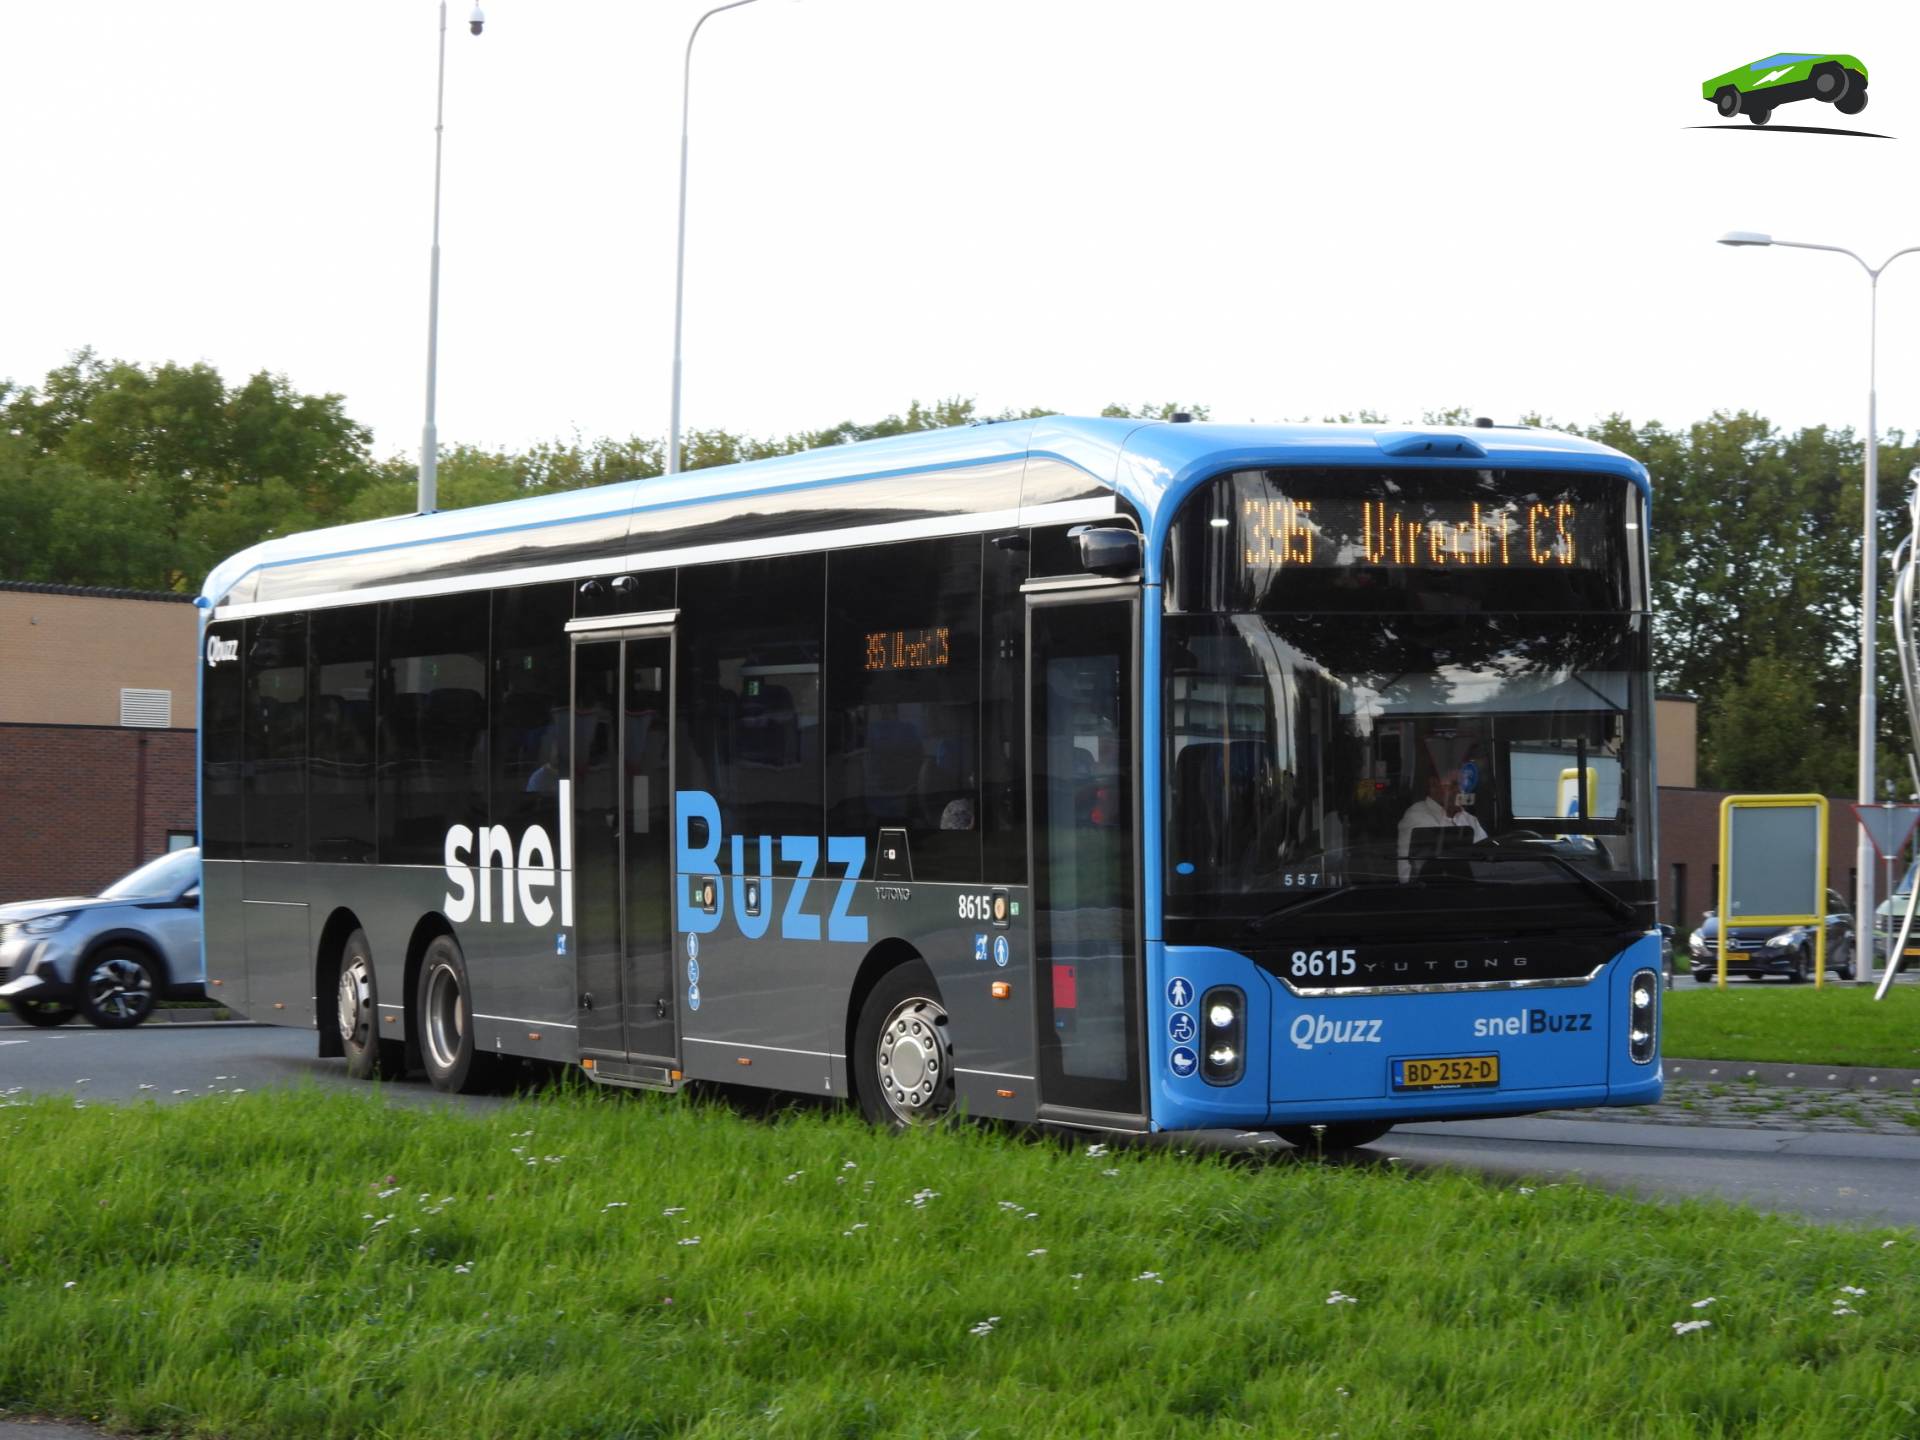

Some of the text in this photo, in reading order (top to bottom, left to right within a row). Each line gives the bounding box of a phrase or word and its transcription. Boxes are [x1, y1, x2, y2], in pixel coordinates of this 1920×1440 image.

[1245, 501, 1575, 564] 395 Utrecht CS
[443, 779, 869, 943] snel Buzz
[875, 886, 912, 902] YUTONG
[958, 894, 990, 920] 8615
[1291, 949, 1357, 977] 8615
[1364, 957, 1527, 972] YUTONG
[1290, 1014, 1383, 1050] Qbuzz
[1474, 1009, 1592, 1037] snelBuzz
[1407, 1061, 1492, 1082] BD-252-D
